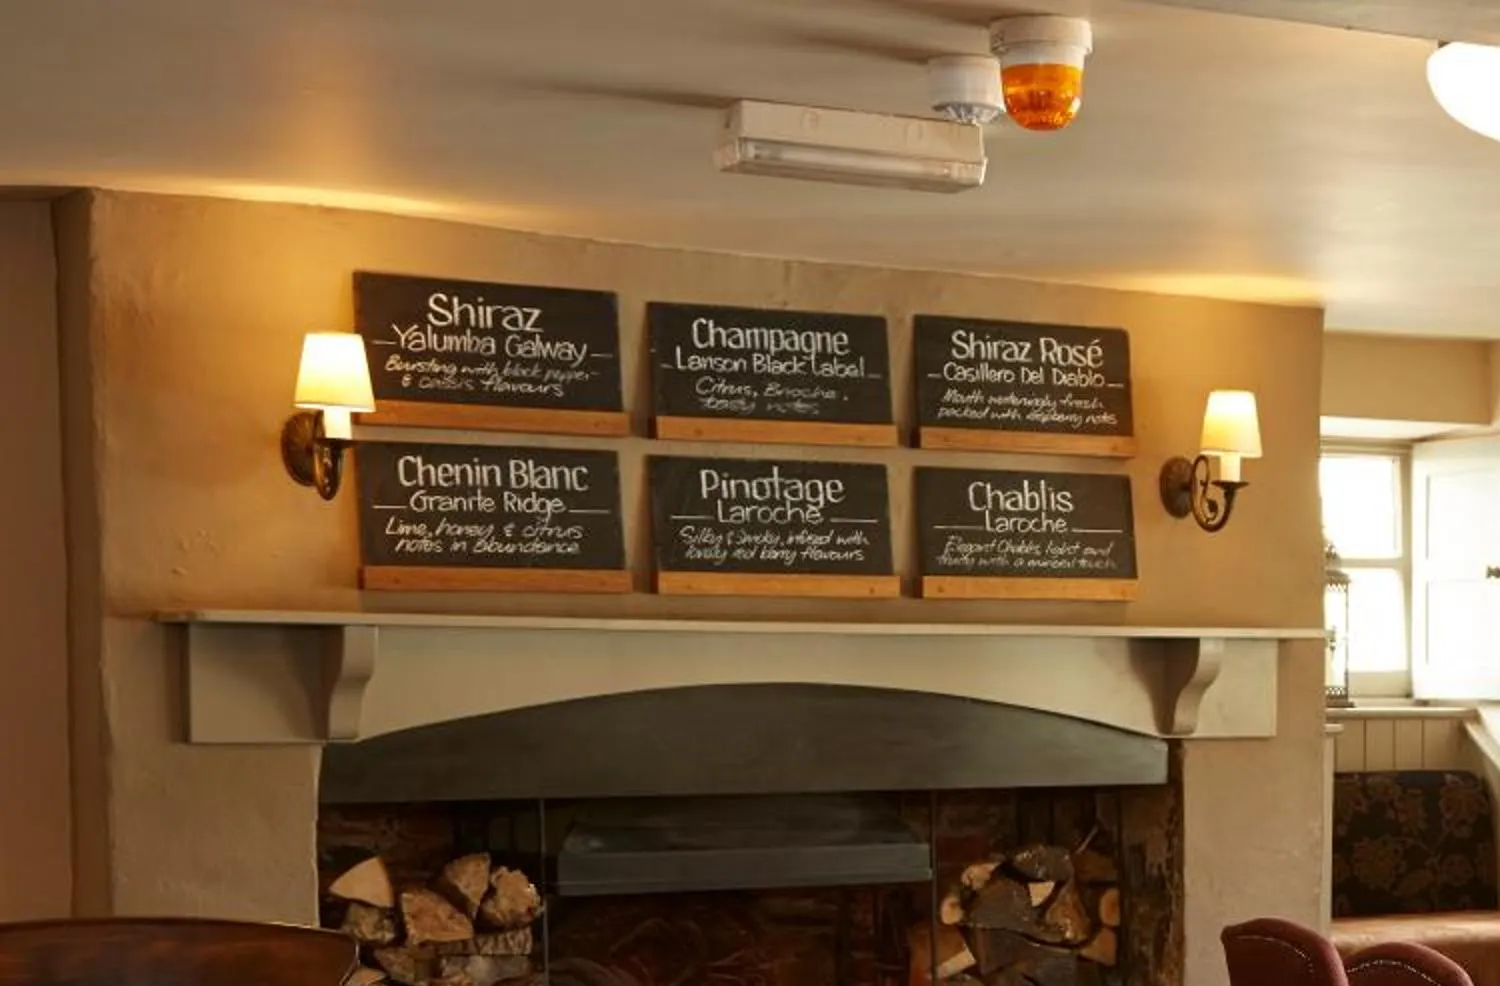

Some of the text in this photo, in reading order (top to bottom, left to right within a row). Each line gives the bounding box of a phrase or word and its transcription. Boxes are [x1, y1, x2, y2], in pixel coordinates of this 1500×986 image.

[427, 293, 544, 333] Shiraz
[391, 323, 588, 369] Yalumba Galway
[692, 317, 850, 356] Champagne
[951, 330, 1104, 368] Shiraz Rosé
[675, 345, 748, 373] Lanson
[752, 353, 807, 376] Black
[943, 362, 1106, 388] Casillero Del Diablo
[398, 455, 589, 492] Chenin Blanc
[700, 465, 848, 509] Pinotage
[409, 488, 567, 523] Granite Ridge
[717, 499, 825, 525] Laroche
[968, 480, 1075, 513] Chablis
[385, 516, 433, 538] Lime,
[435, 517, 495, 541] honey
[984, 510, 1069, 533] Laroche
[395, 536, 581, 554] notes in abundance
